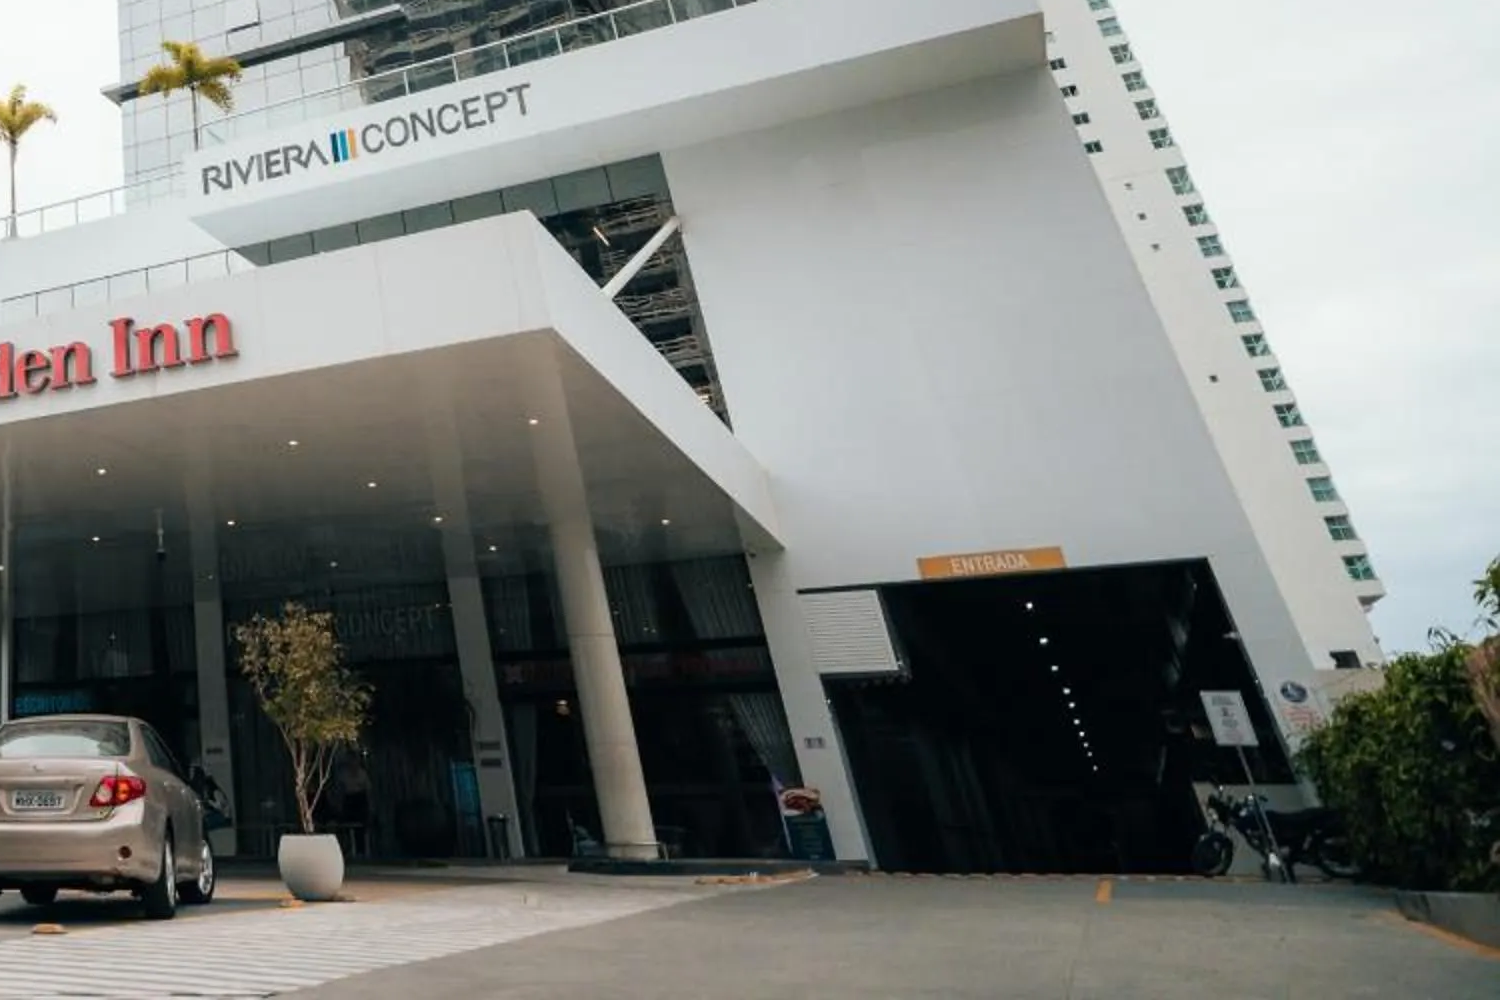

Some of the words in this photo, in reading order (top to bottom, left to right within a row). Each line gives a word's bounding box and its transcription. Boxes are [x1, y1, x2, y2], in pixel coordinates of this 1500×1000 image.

[201, 139, 329, 195] RIVIERA
[361, 83, 531, 154] CONCEPT
[109, 312, 238, 379] Inn
[950, 553, 1031, 575] ENTRADA
